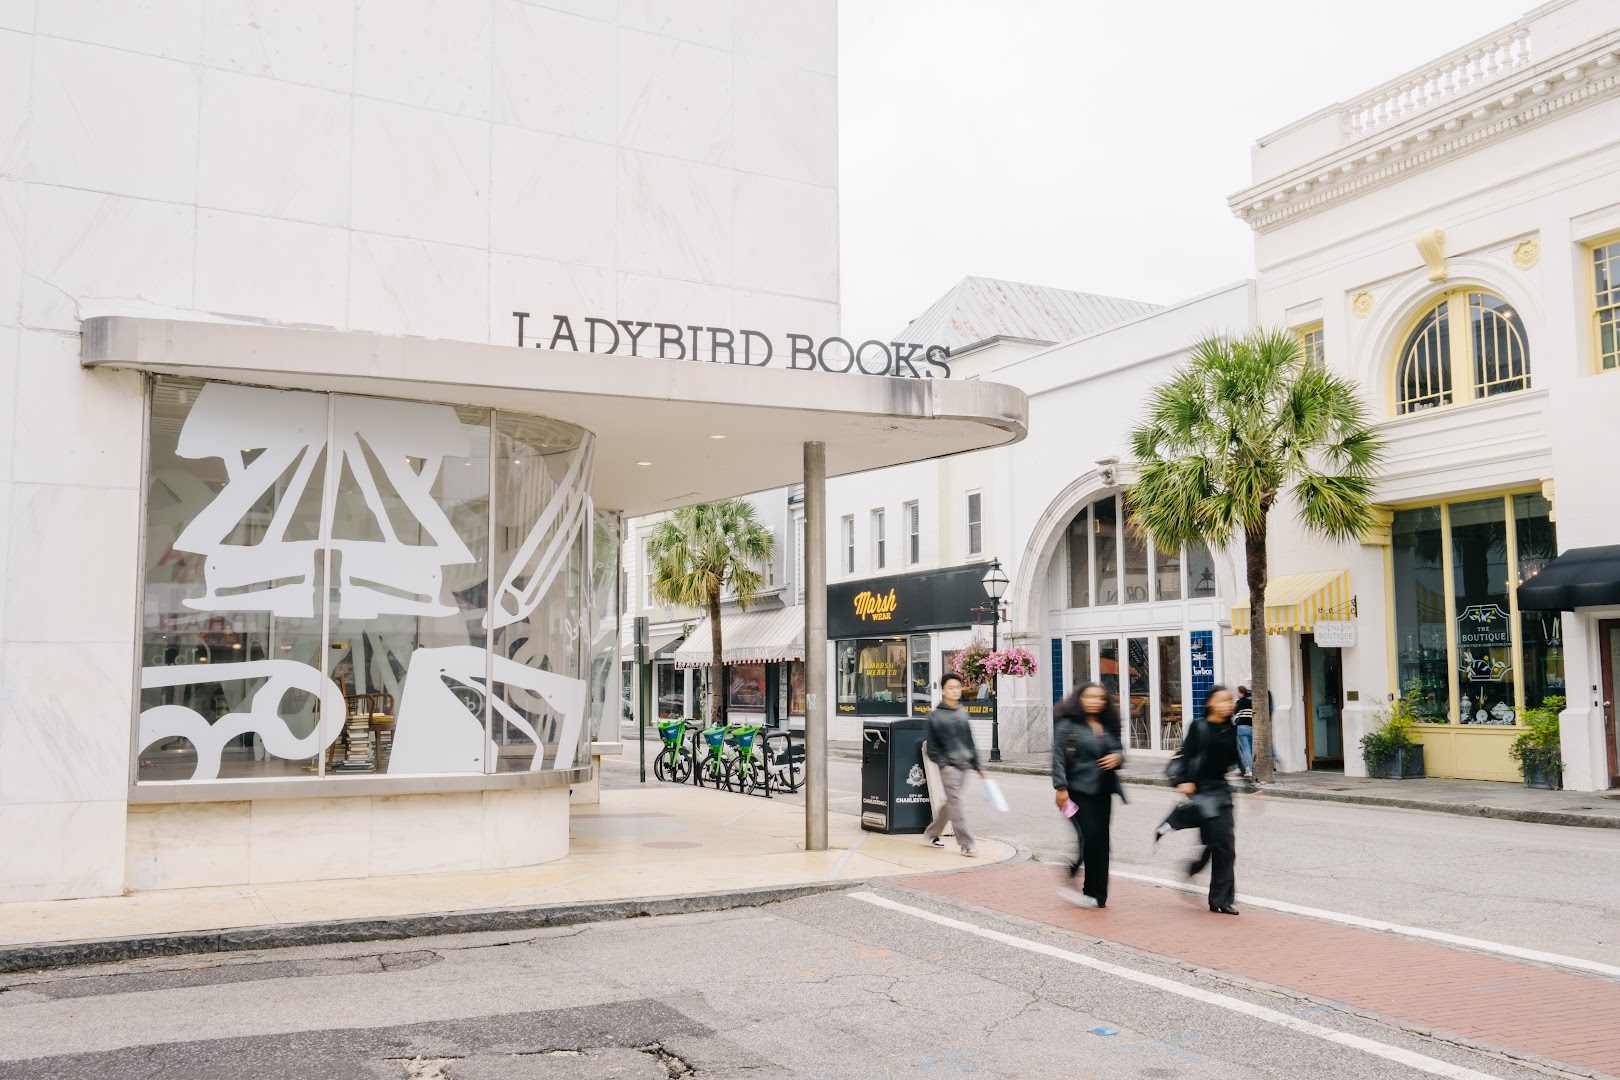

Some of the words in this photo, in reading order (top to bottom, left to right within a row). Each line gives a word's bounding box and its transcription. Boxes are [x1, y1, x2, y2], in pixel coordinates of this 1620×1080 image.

[512, 311, 773, 367] LADYBIRD
[786, 333, 951, 379] BOOKS
[854, 588, 897, 621] Marsh
[872, 612, 891, 621] WEAR
[1462, 633, 1506, 642] BOUTIQUE
